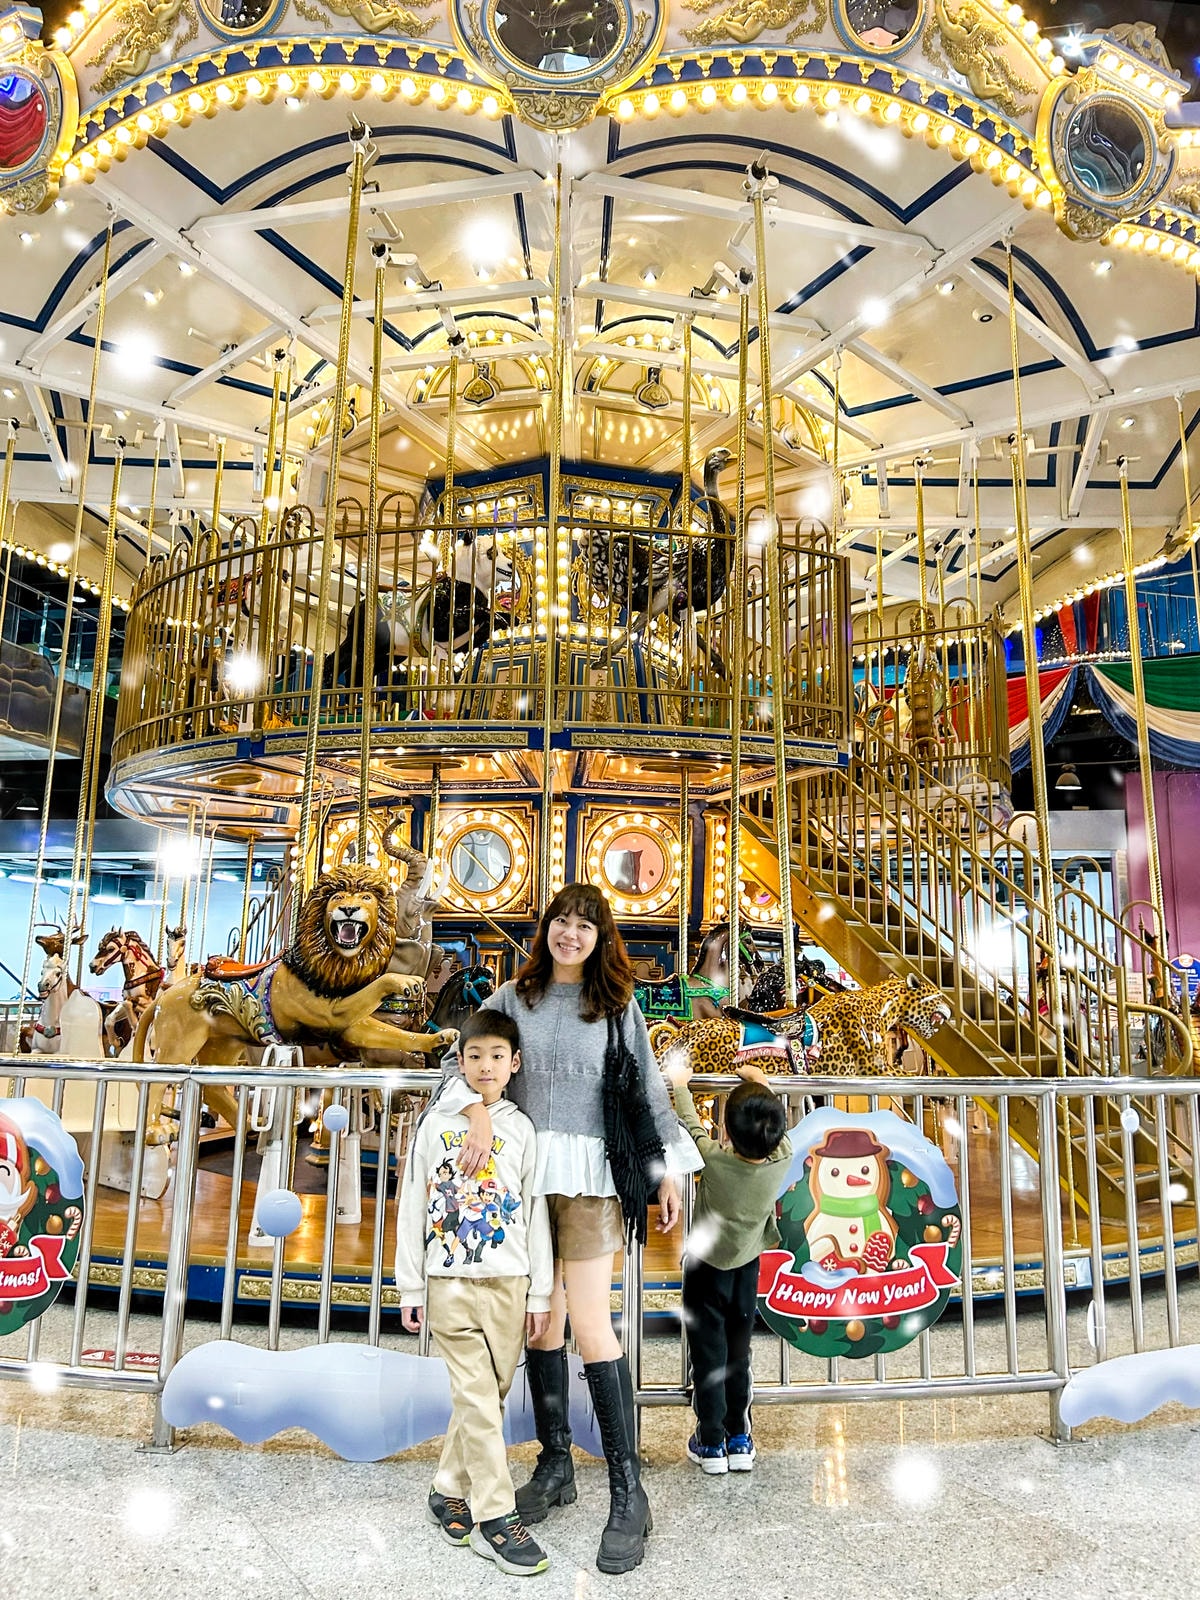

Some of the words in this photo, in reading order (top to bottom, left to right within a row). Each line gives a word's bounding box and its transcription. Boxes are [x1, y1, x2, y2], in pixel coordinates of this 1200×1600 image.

[776, 1283, 837, 1309] Happy
[841, 1288, 879, 1306] New
[883, 1276, 926, 1305] Year!
